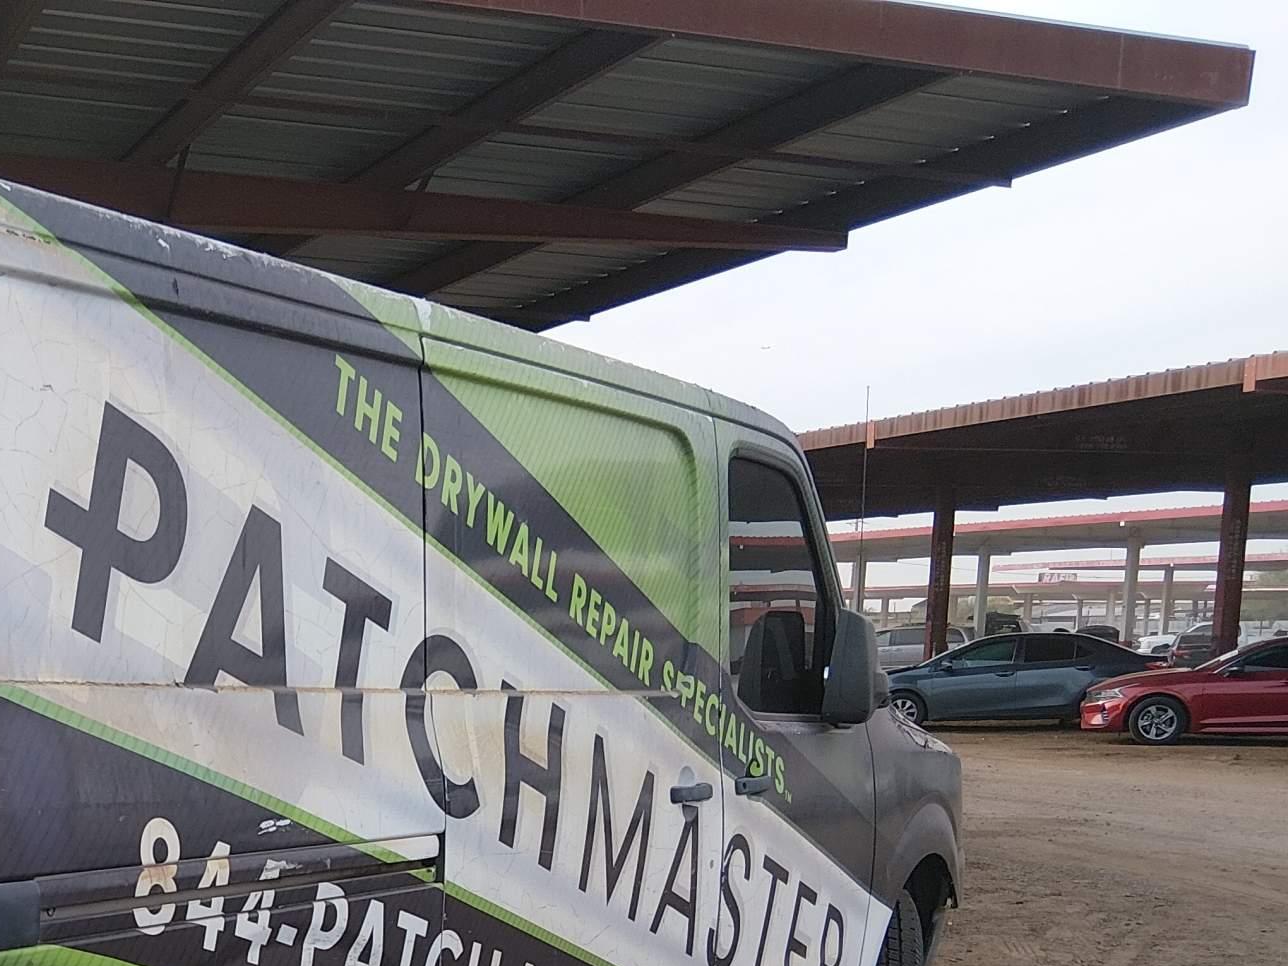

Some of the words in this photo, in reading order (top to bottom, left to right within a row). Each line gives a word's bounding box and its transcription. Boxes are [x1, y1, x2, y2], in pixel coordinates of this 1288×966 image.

[335, 354, 403, 462] THE
[415, 431, 560, 602] DRYWALL
[569, 572, 654, 687] REPAIR
